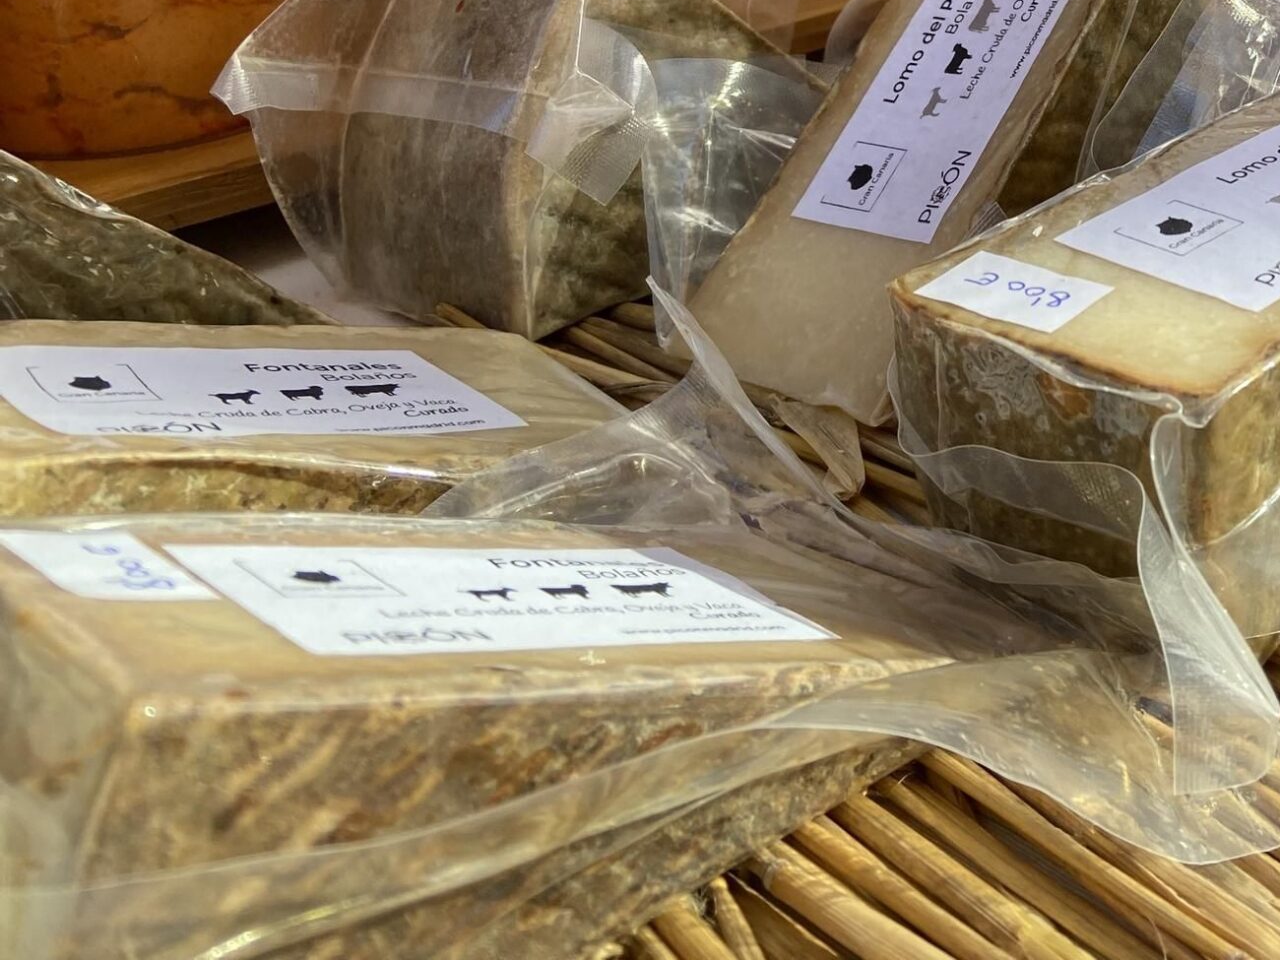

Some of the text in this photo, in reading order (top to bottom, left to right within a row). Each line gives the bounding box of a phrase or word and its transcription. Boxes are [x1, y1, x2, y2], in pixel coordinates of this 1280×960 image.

[882, 50, 926, 105] Lomo
[921, 15, 947, 46] del
[959, 64, 987, 101] Leche
[981, 27, 1009, 64] Cruda
[1004, 10, 1018, 34] de
[1216, 153, 1278, 186] Lomo
[857, 151, 896, 207] Gran Canaria
[244, 362, 403, 373] Fontanales
[320, 370, 418, 382] Bolaños
[197, 408, 259, 419] Cruda
[260, 407, 284, 418] de
[284, 405, 348, 418] Cabra,
[402, 406, 470, 418] Curado
[487, 557, 667, 570] Fontanales
[576, 567, 689, 580] Bolaños
[525, 605, 555, 616] de
